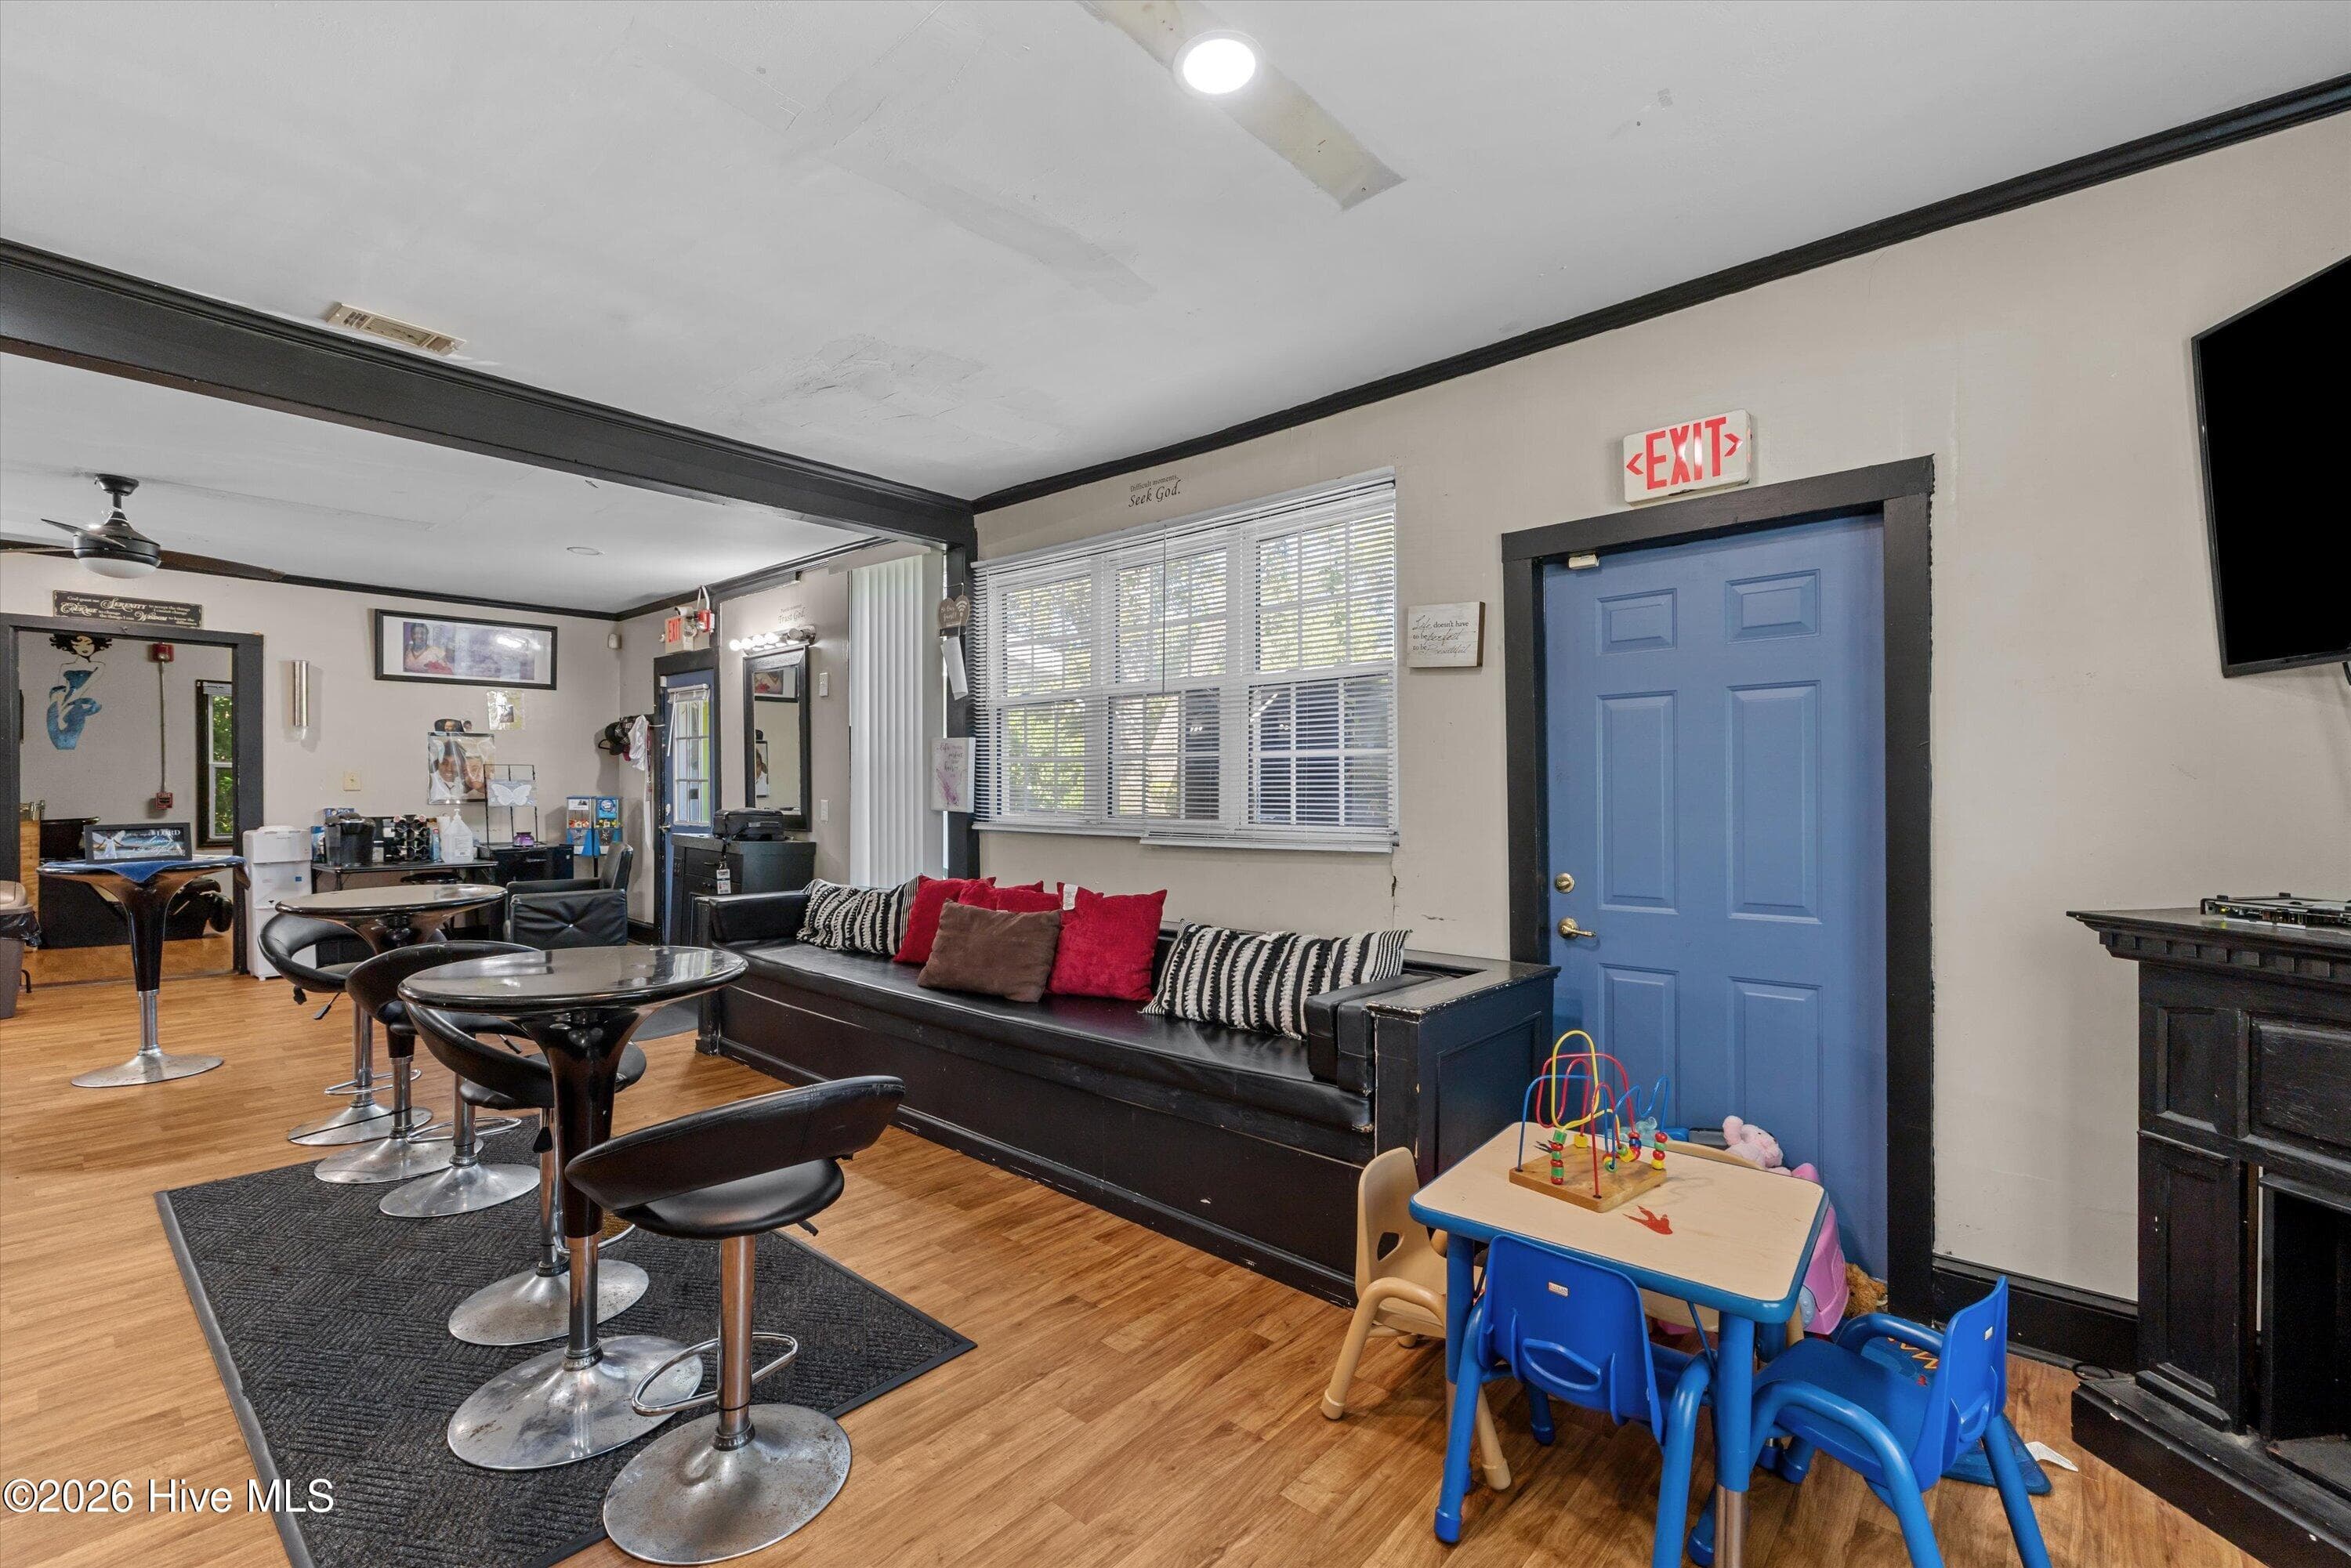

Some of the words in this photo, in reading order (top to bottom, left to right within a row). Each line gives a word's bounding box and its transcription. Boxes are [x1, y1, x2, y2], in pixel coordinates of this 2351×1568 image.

[1646, 417, 1726, 490] EXIT
[1128, 487, 1152, 507] Seek
[1156, 479, 1181, 502] God.
[668, 617, 681, 643] EXIT
